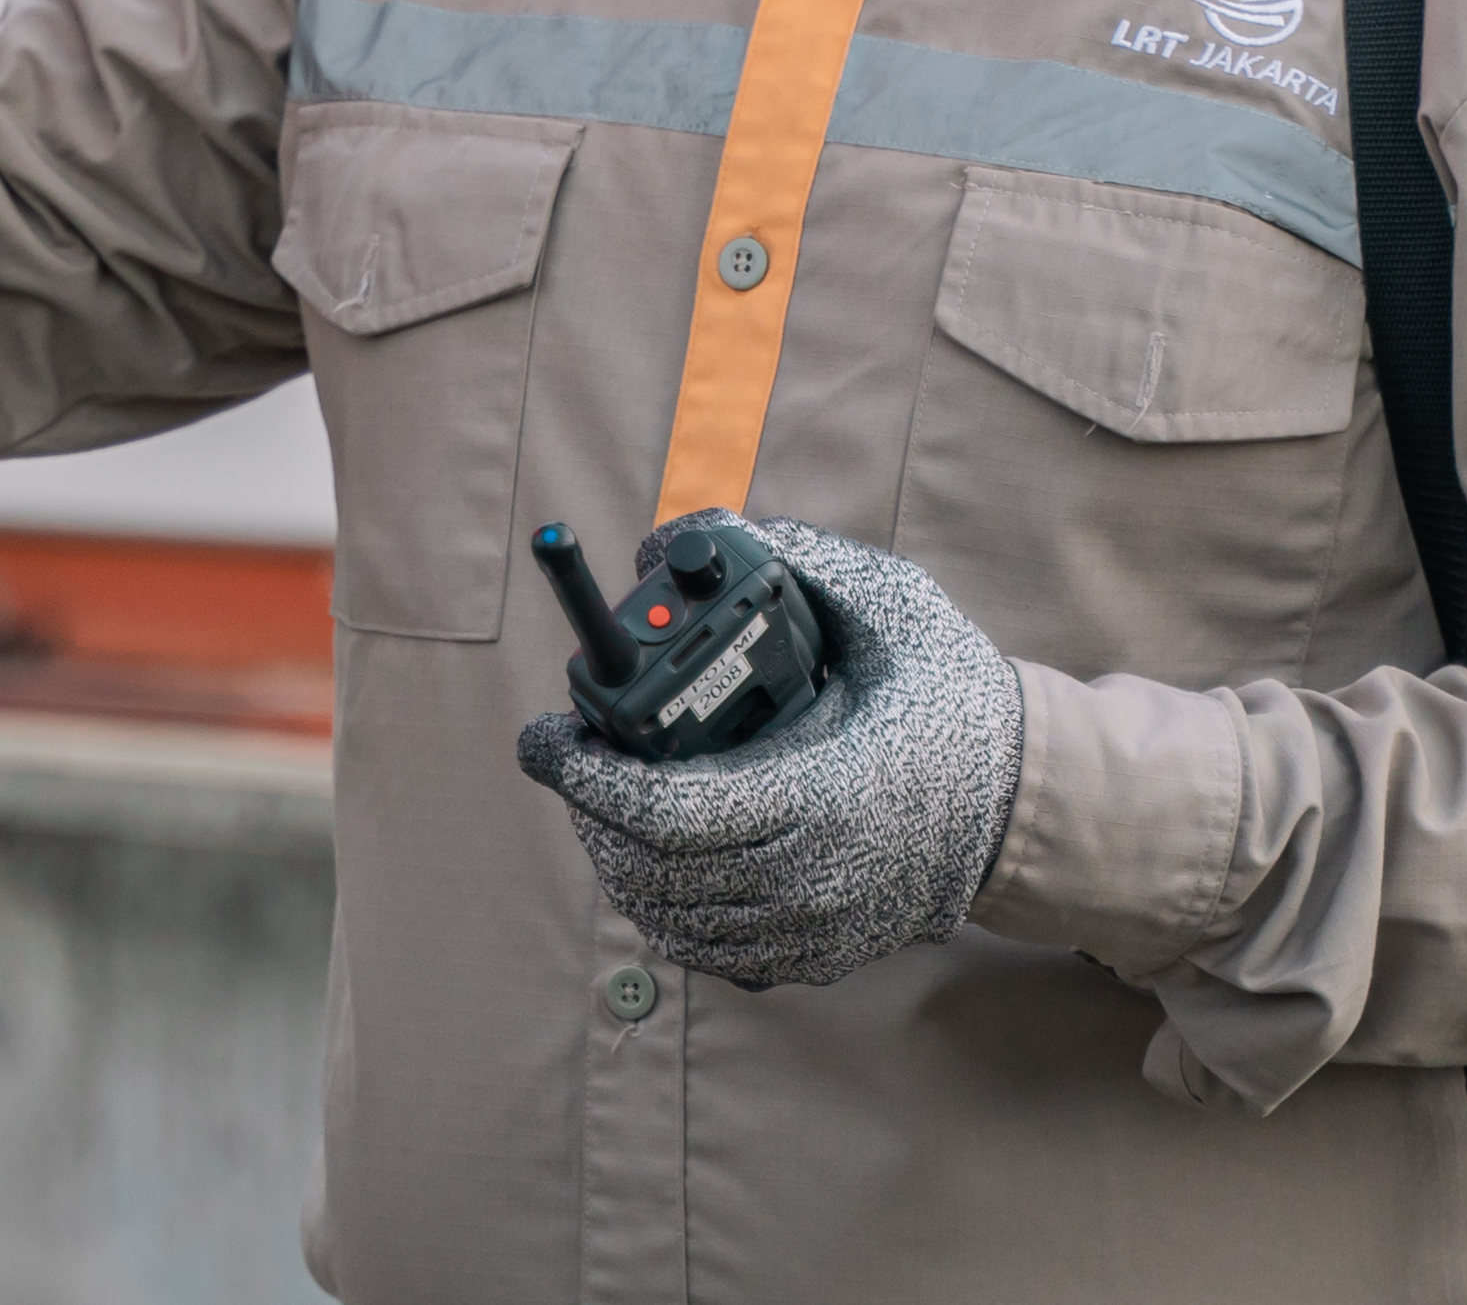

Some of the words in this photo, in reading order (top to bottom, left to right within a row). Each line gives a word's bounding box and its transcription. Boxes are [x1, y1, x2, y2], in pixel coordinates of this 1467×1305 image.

[1110, 18, 1190, 59] LRT
[1188, 41, 1340, 116] JAKARTA
[666, 652, 729, 718] DEPOT
[699, 664, 743, 711] 2008
